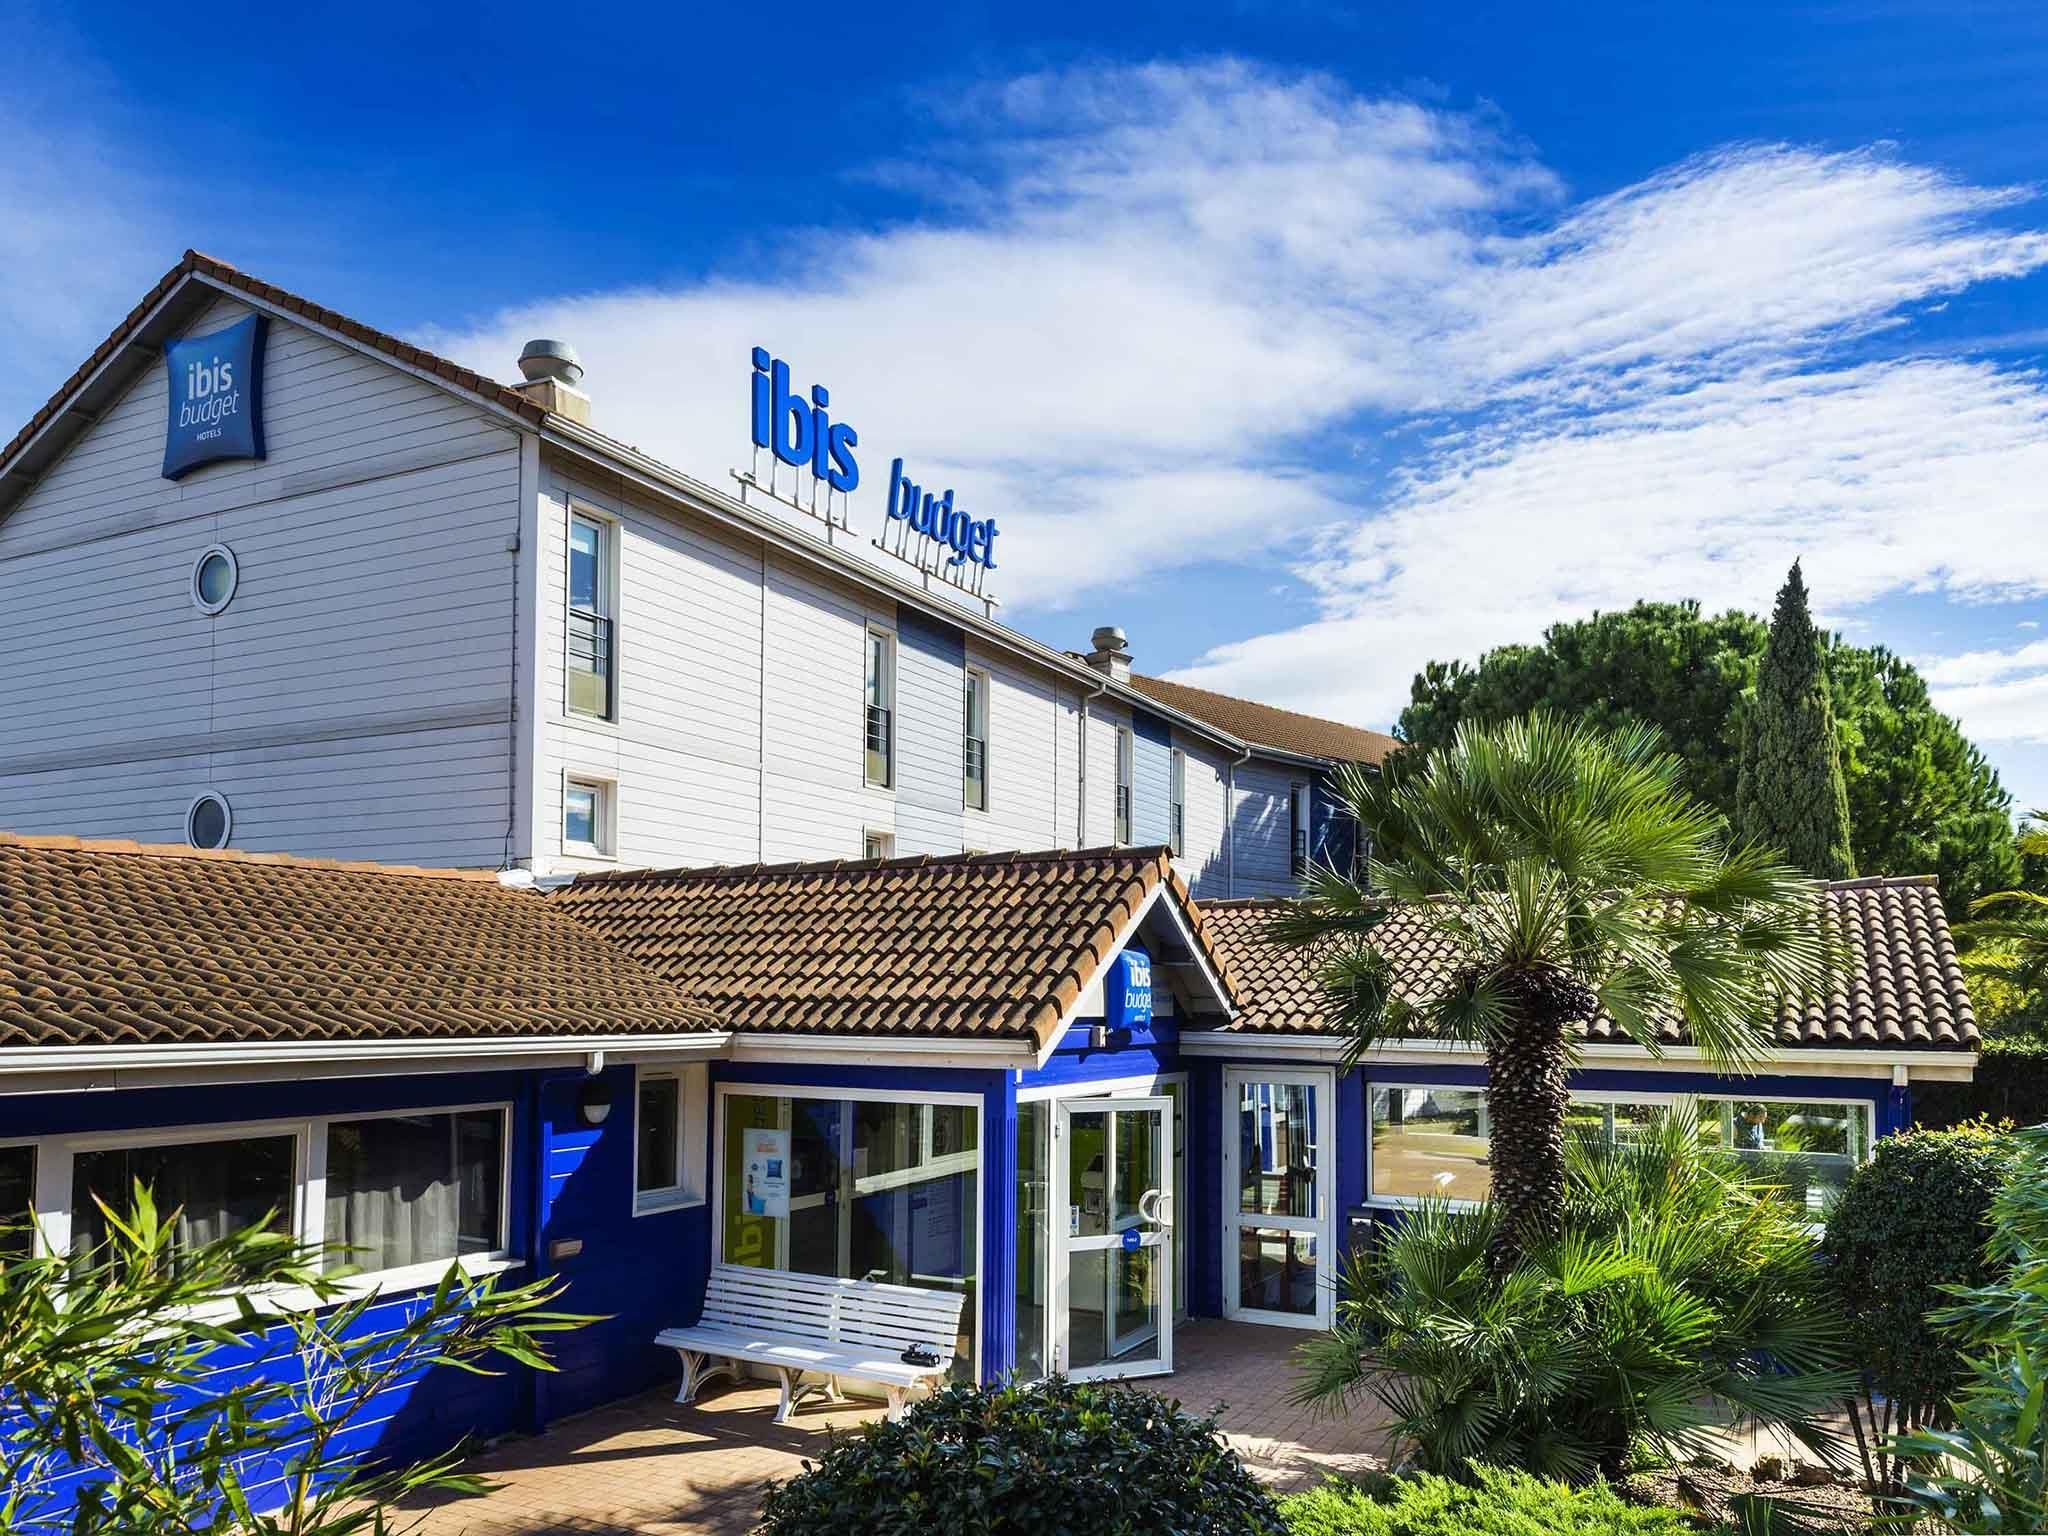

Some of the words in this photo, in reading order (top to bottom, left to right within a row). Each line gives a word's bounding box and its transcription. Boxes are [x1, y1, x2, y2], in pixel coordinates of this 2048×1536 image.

[188, 356, 233, 400] ibis
[180, 390, 240, 428] budget
[196, 427, 222, 441] HOTELS
[752, 346, 859, 493] ibis
[888, 457, 1000, 570] budget
[1129, 958, 1151, 987] ibis
[1125, 988, 1152, 1012] budge
